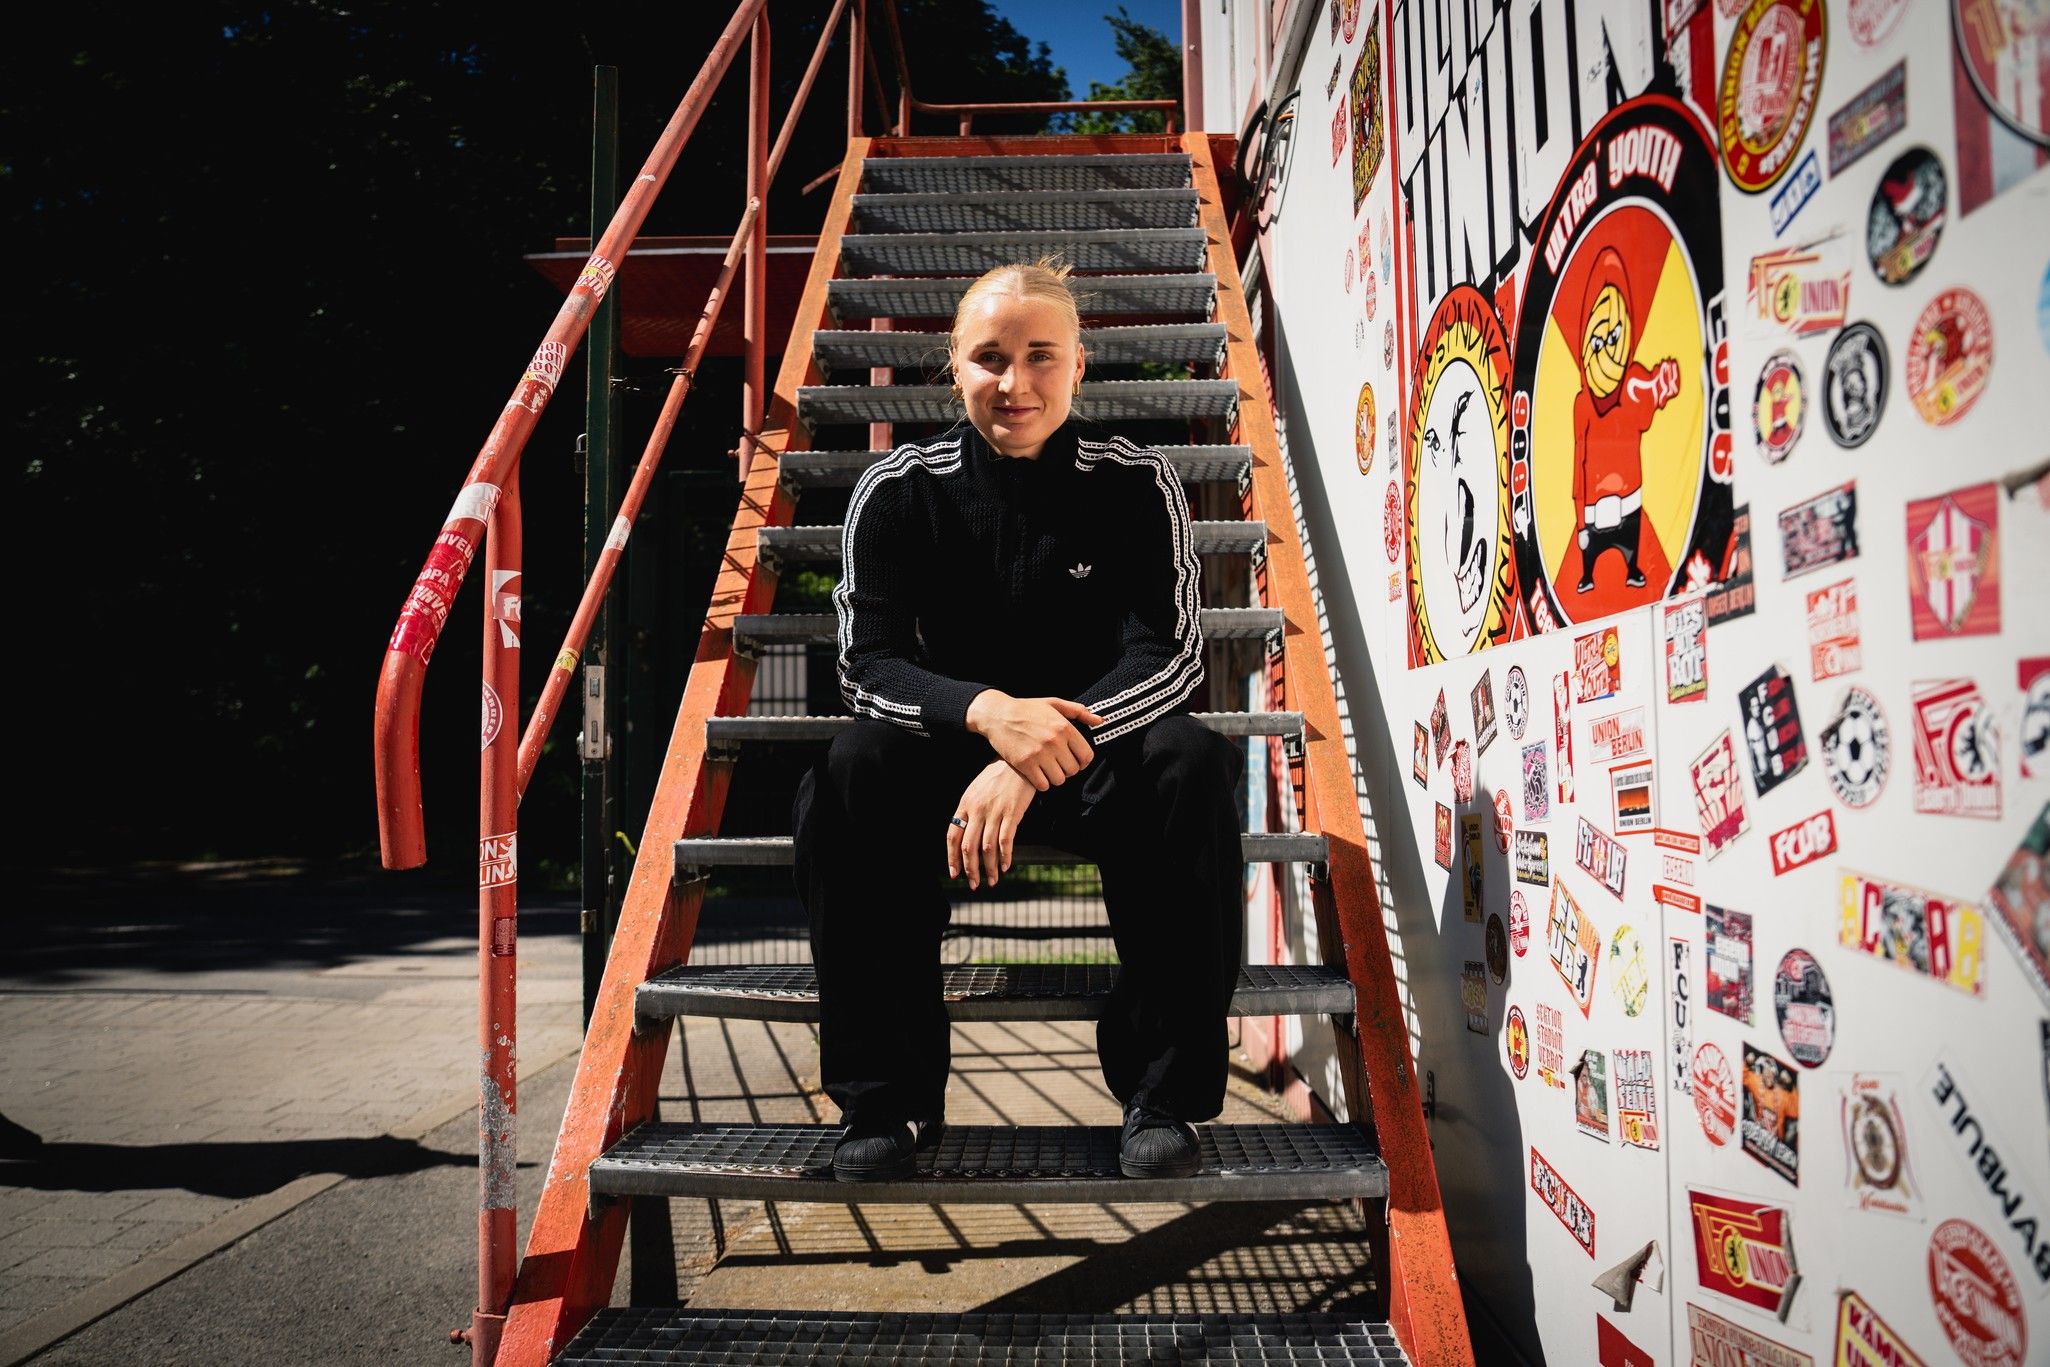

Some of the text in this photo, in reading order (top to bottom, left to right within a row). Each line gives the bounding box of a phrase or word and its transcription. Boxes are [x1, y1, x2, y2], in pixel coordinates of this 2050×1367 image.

[1801, 279, 1840, 314] UNION
[1591, 717, 1619, 744] UNION
[1611, 729, 1643, 756] BERLIN
[1773, 813, 1832, 869] FCUB
